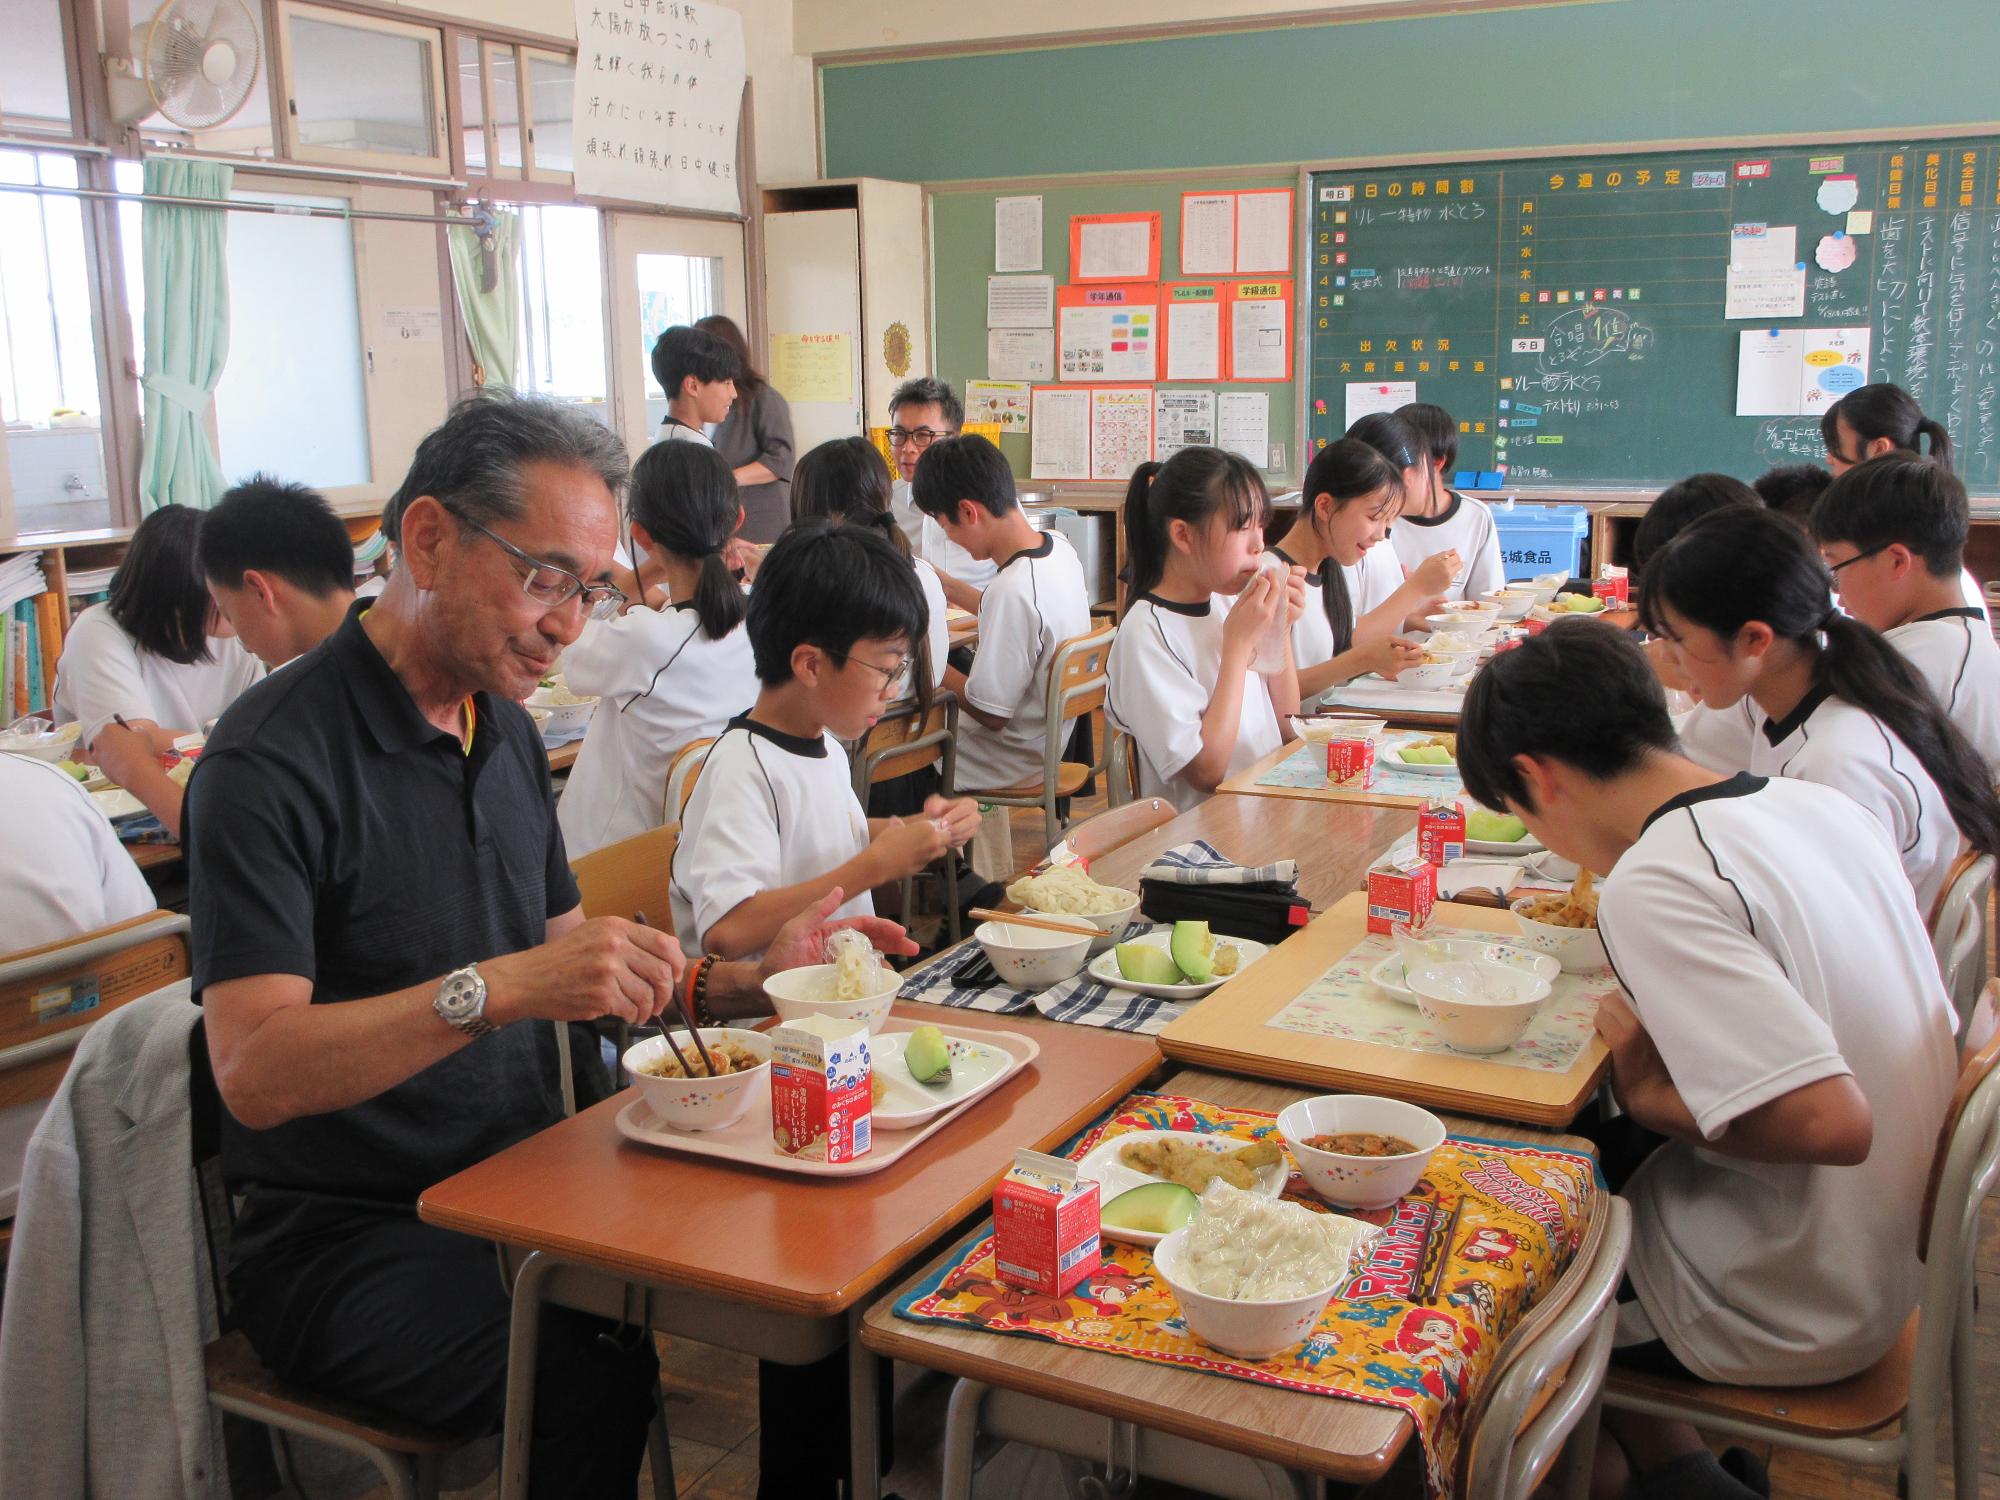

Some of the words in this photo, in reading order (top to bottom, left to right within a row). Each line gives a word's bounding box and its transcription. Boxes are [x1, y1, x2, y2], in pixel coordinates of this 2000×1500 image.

[1550, 169, 1681, 190] 今週の予定
[1923, 152, 1940, 208] 美化目標
[1959, 151, 1977, 207] 安全目標
[1522, 202, 1533, 213] 月
[1521, 225, 1533, 236] 火
[1520, 247, 1532, 259] 水
[1520, 269, 1532, 281] 木
[1519, 291, 1531, 303] 金
[1518, 313, 1529, 325] 土
[1359, 338, 1450, 353] 出欠状況
[1518, 341, 1538, 350] 今日
[1340, 361, 1376, 373] 欠席
[1394, 361, 1430, 373] 遅刻
[1448, 360, 1486, 373] 早退
[790, 1088, 801, 1149] おいしい牛乳
